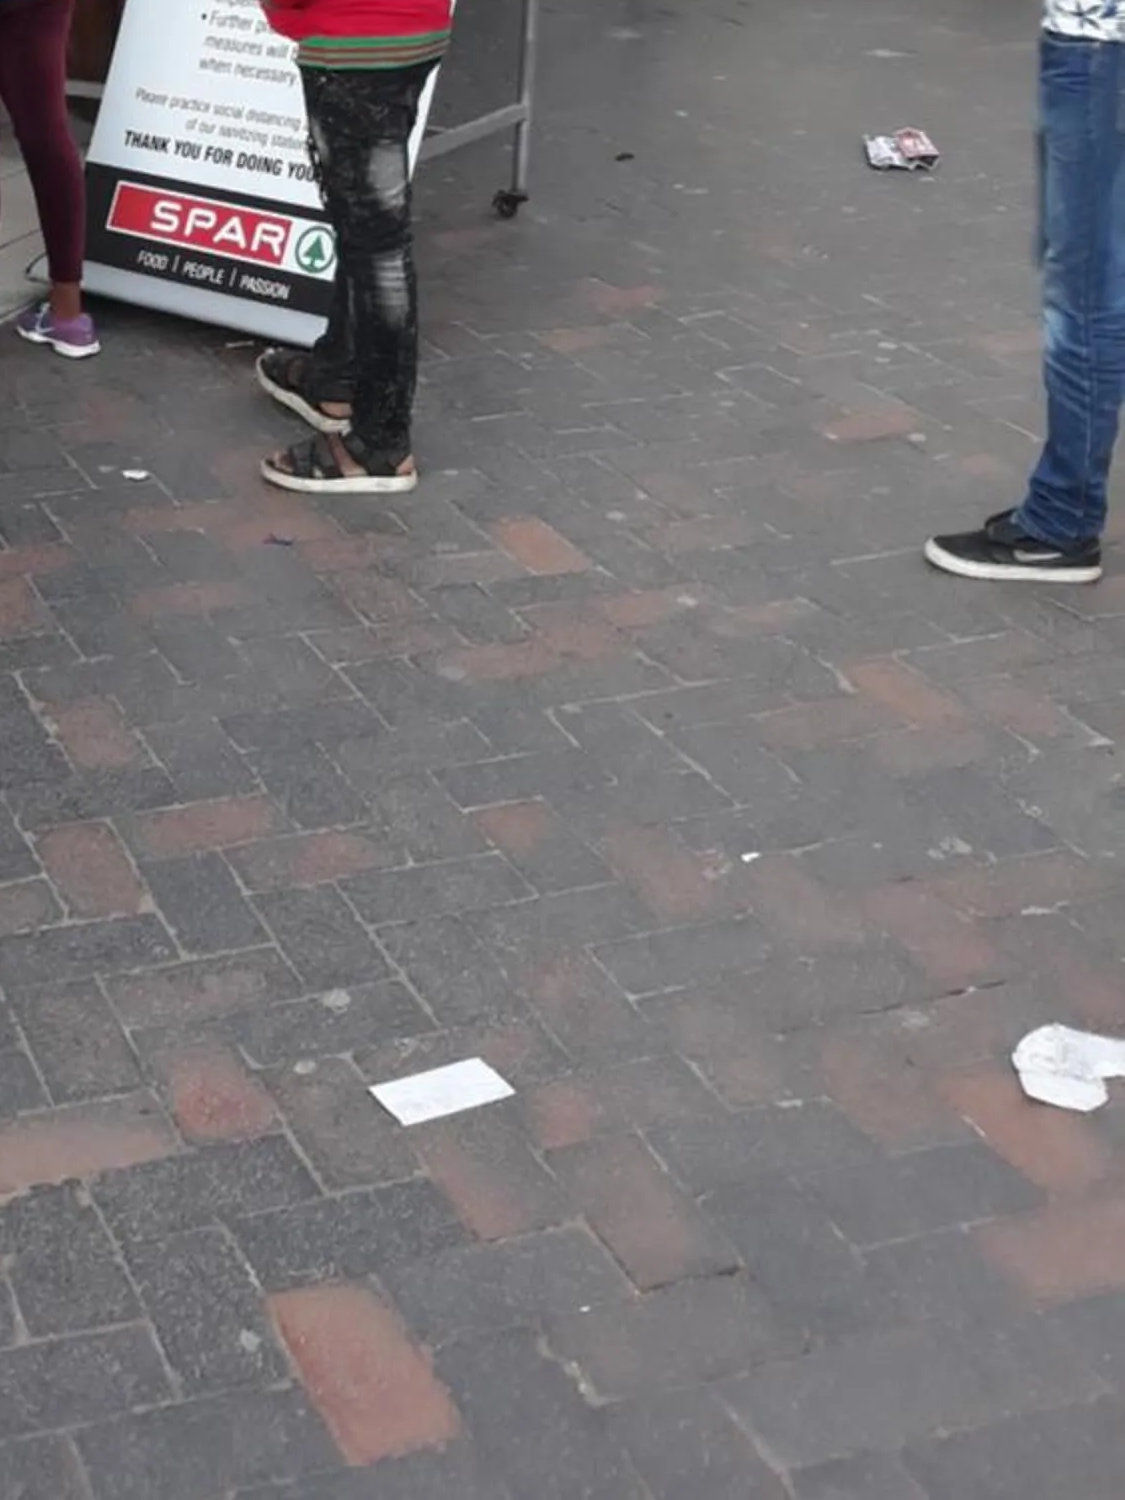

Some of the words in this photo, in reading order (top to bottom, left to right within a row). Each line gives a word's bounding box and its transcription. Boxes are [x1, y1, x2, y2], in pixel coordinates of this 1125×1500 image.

[203, 35, 262, 56] measures
[208, 9, 255, 31] Further
[124, 129, 172, 154] THANK
[173, 139, 203, 161] YOU
[203, 145, 235, 167] FOR
[236, 151, 284, 178] DOING
[287, 161, 321, 183] YOU
[150, 201, 287, 257] SPAR
[136, 249, 170, 271] FOOD
[182, 261, 226, 286] PEOPLE
[239, 274, 292, 300] PASSION
